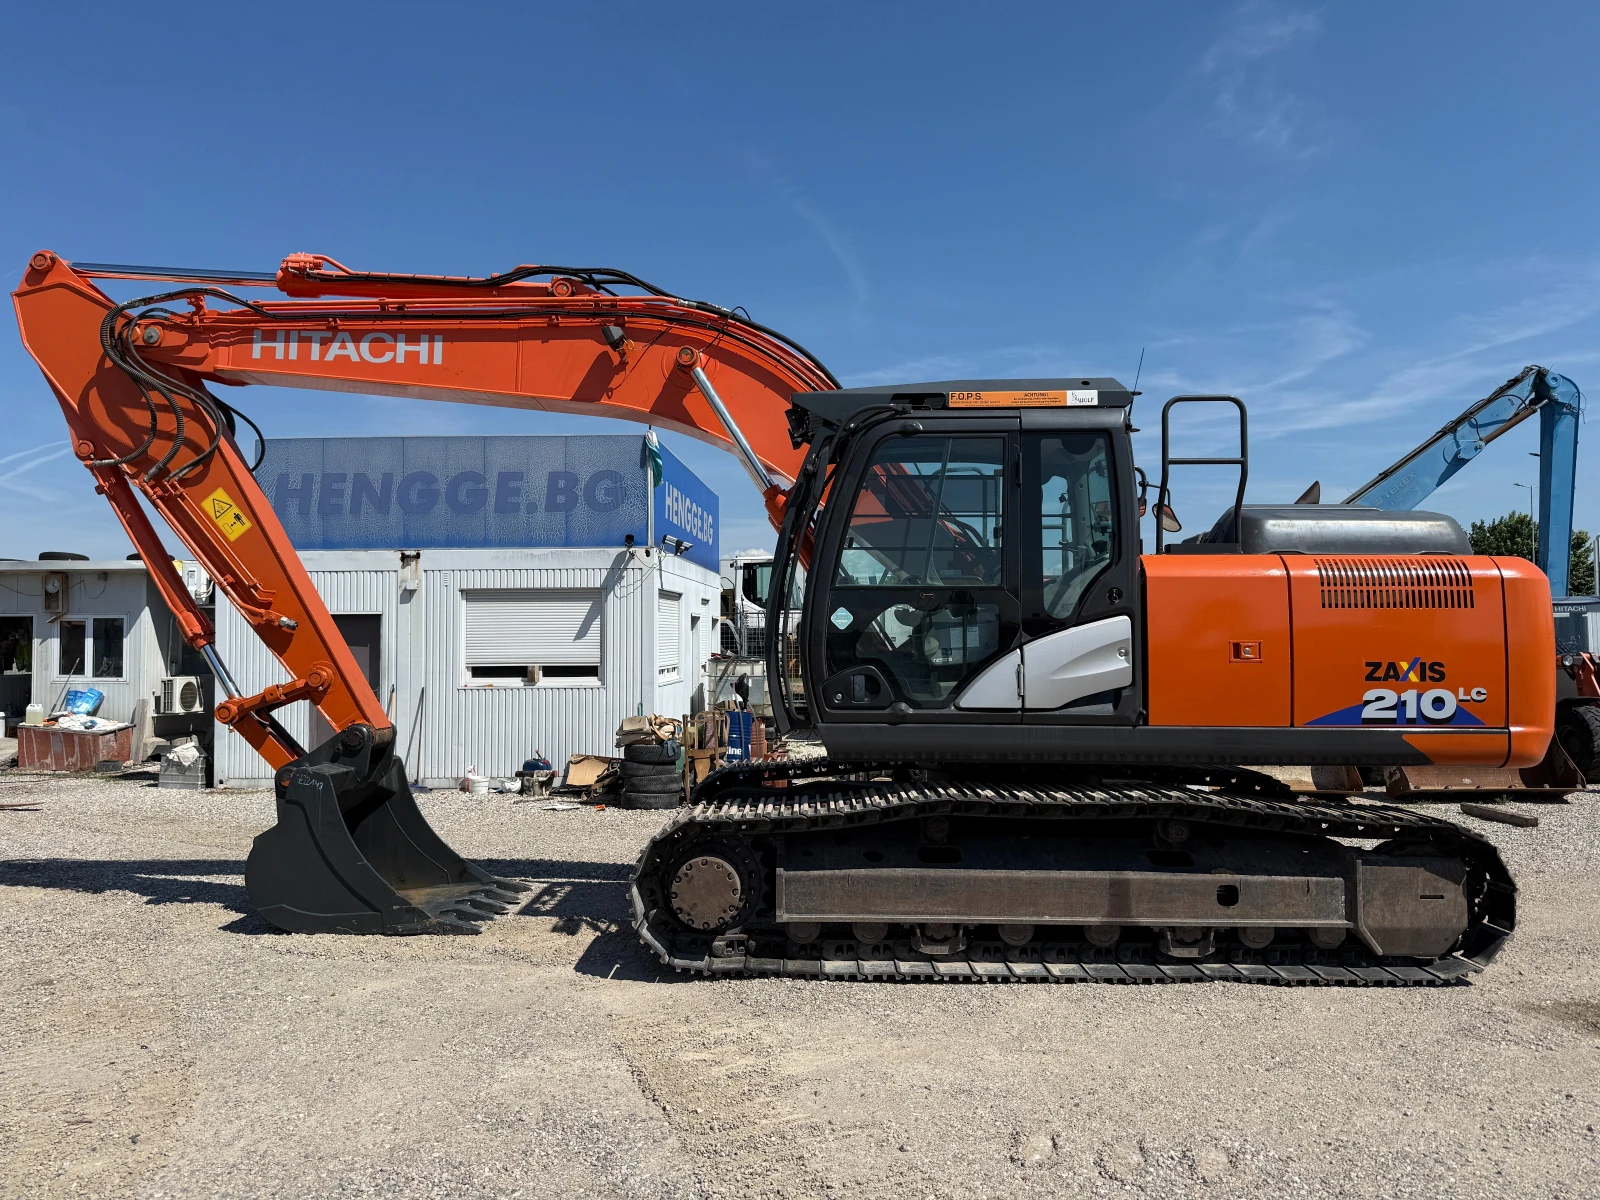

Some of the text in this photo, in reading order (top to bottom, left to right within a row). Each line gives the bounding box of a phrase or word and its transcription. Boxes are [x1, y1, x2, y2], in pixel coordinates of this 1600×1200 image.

[251, 329, 443, 365] HITACHI
[272, 469, 627, 516] HENGGE.BG
[1384, 471, 1416, 498] TEREX
[665, 480, 713, 546] HENGGE.BG
[1364, 656, 1446, 682] ZAXIS
[1361, 687, 1487, 724] 210 LC
